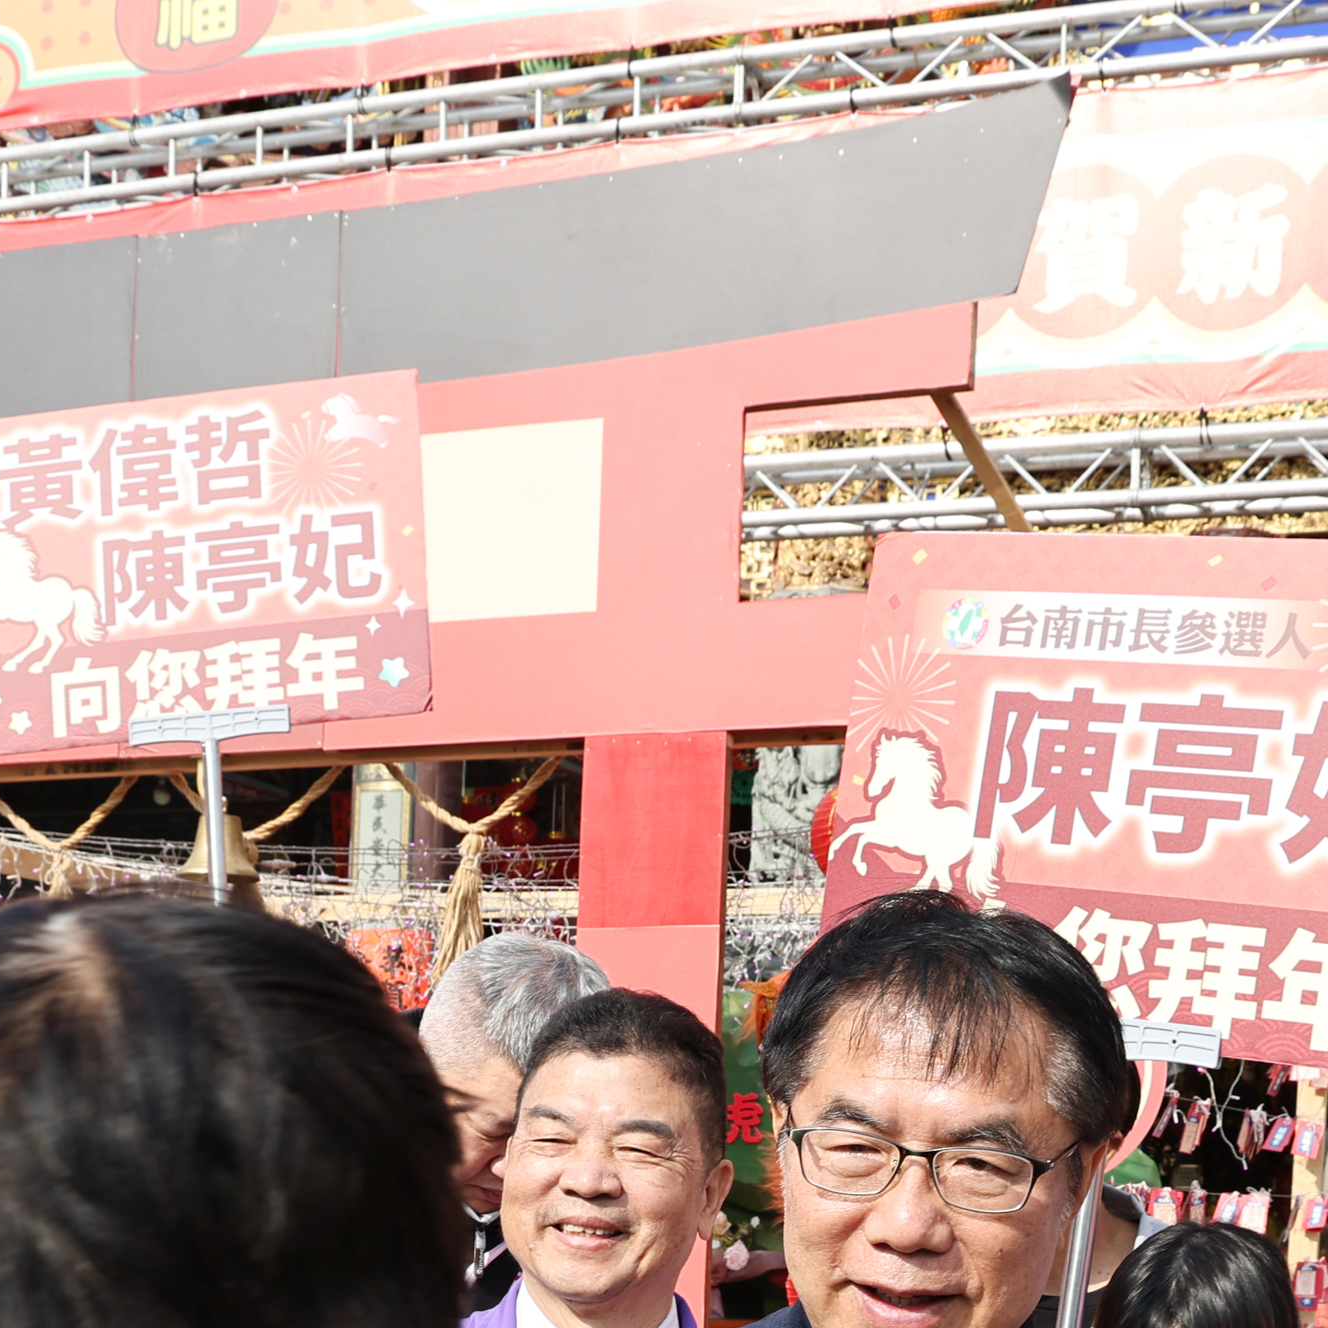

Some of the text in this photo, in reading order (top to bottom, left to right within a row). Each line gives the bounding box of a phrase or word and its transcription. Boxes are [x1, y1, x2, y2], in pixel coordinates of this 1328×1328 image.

[101, 510, 383, 627] 陳亭妃
[996, 602, 1313, 661] 台南市長參選人
[49, 632, 366, 738] 向您拜年
[725, 1092, 764, 1144] 虎
